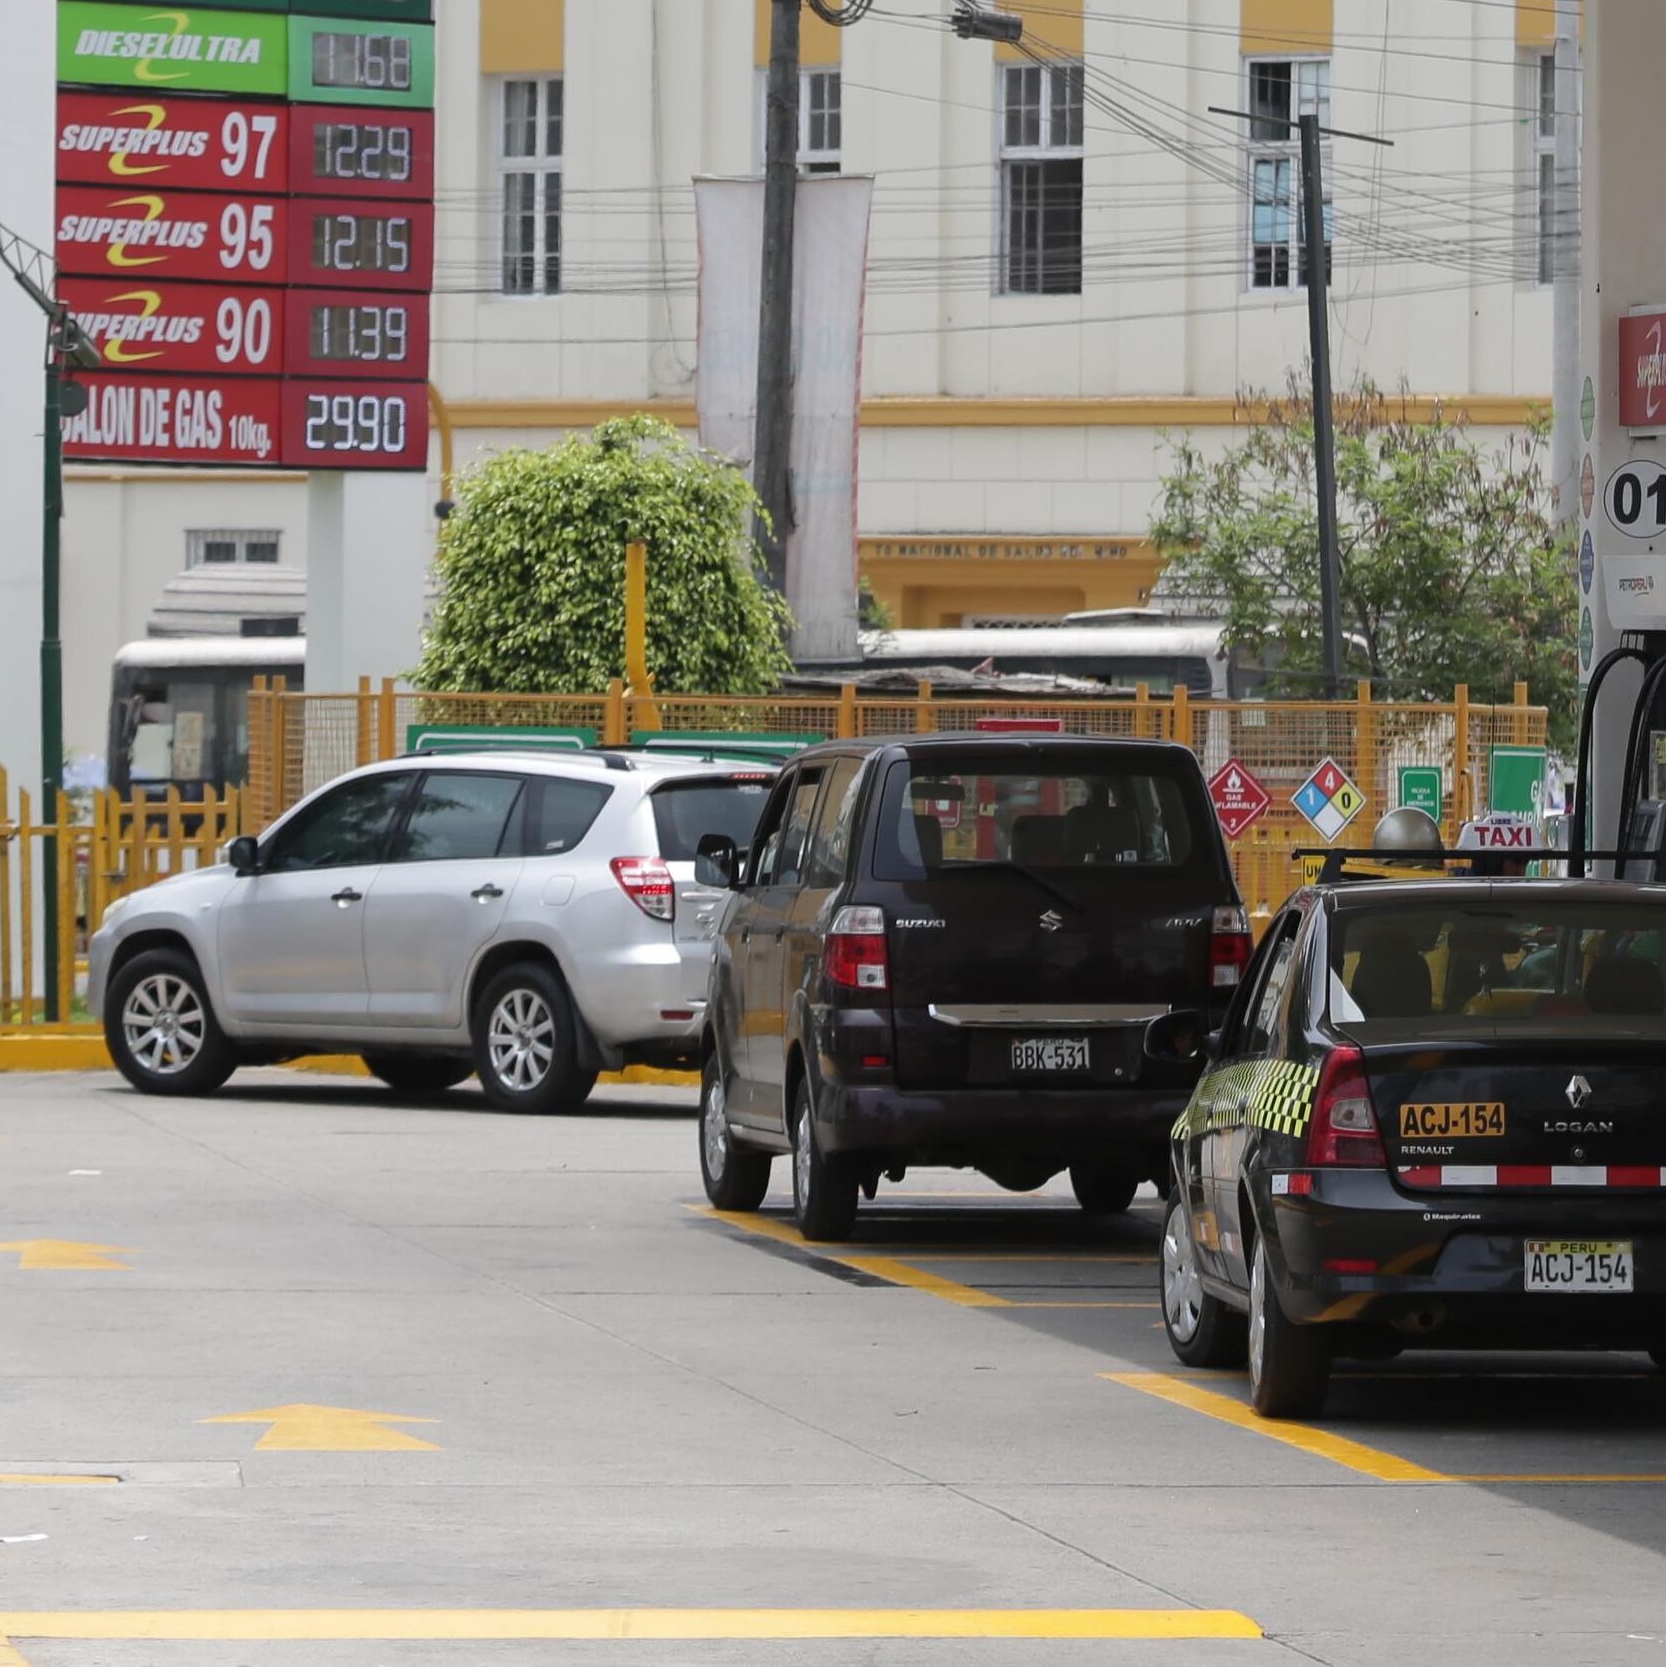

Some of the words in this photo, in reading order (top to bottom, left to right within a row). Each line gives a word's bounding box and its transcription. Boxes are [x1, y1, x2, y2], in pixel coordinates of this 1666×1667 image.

[58, 124, 210, 158] SUPERPLUS
[219, 111, 278, 180] 97
[323, 124, 410, 181] 12.29
[57, 214, 209, 249] SUPERPLUS
[218, 202, 275, 271] 95
[322, 215, 408, 273] 12.15
[215, 296, 272, 365] 90
[322, 306, 407, 361] 11.39
[139, 387, 171, 447] DE
[175, 387, 223, 450] GAS
[229, 413, 272, 459] 10kg.
[305, 394, 407, 453] 29.90
[1324, 770, 1335, 790] 4
[1215, 801, 1257, 809] FLAMABLE
[1306, 788, 1315, 807] 1
[1341, 792, 1351, 809] 0
[1230, 818, 1236, 828] 2
[1474, 826, 1532, 847] TAXI
[895, 918, 947, 929] SUZUKI
[1013, 1046, 1085, 1068] BBK-531
[1403, 1105, 1504, 1135] ACJ-154
[1544, 1120, 1615, 1133] LOGAN
[1401, 1145, 1455, 1155] RENAULT
[1560, 1242, 1598, 1253] PERU
[1532, 1253, 1628, 1284] ACJ-154
